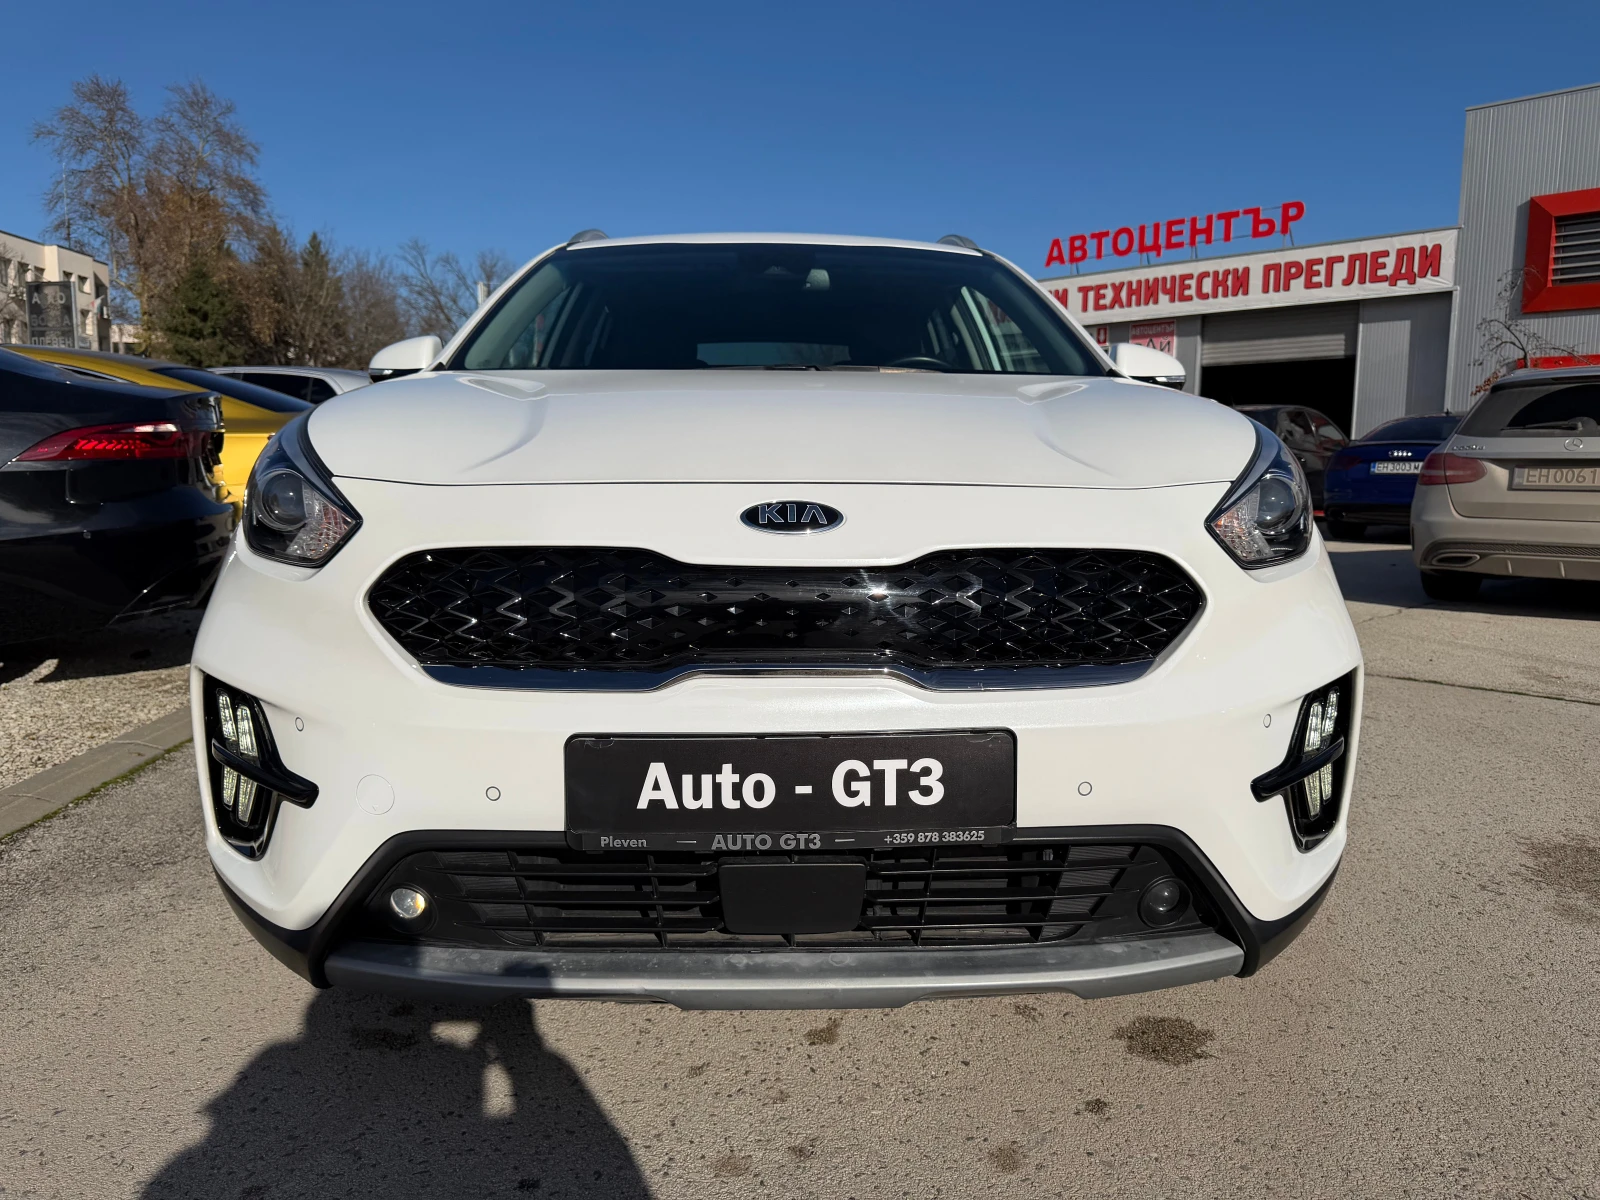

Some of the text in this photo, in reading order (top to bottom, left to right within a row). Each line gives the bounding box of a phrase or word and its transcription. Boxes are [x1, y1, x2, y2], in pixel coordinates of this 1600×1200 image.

[1044, 201, 1305, 268] АВТОЦЕНТЪР
[1077, 266, 1250, 313] ТЕХНИЧЕСКИ
[1262, 244, 1442, 294] ПРЕГЛЕДИ
[758, 503, 828, 525] KIA
[636, 762, 776, 810] Auto
[831, 757, 945, 807] GT3
[600, 830, 985, 850] Pleven AUTO GT3 +359 878 383625
